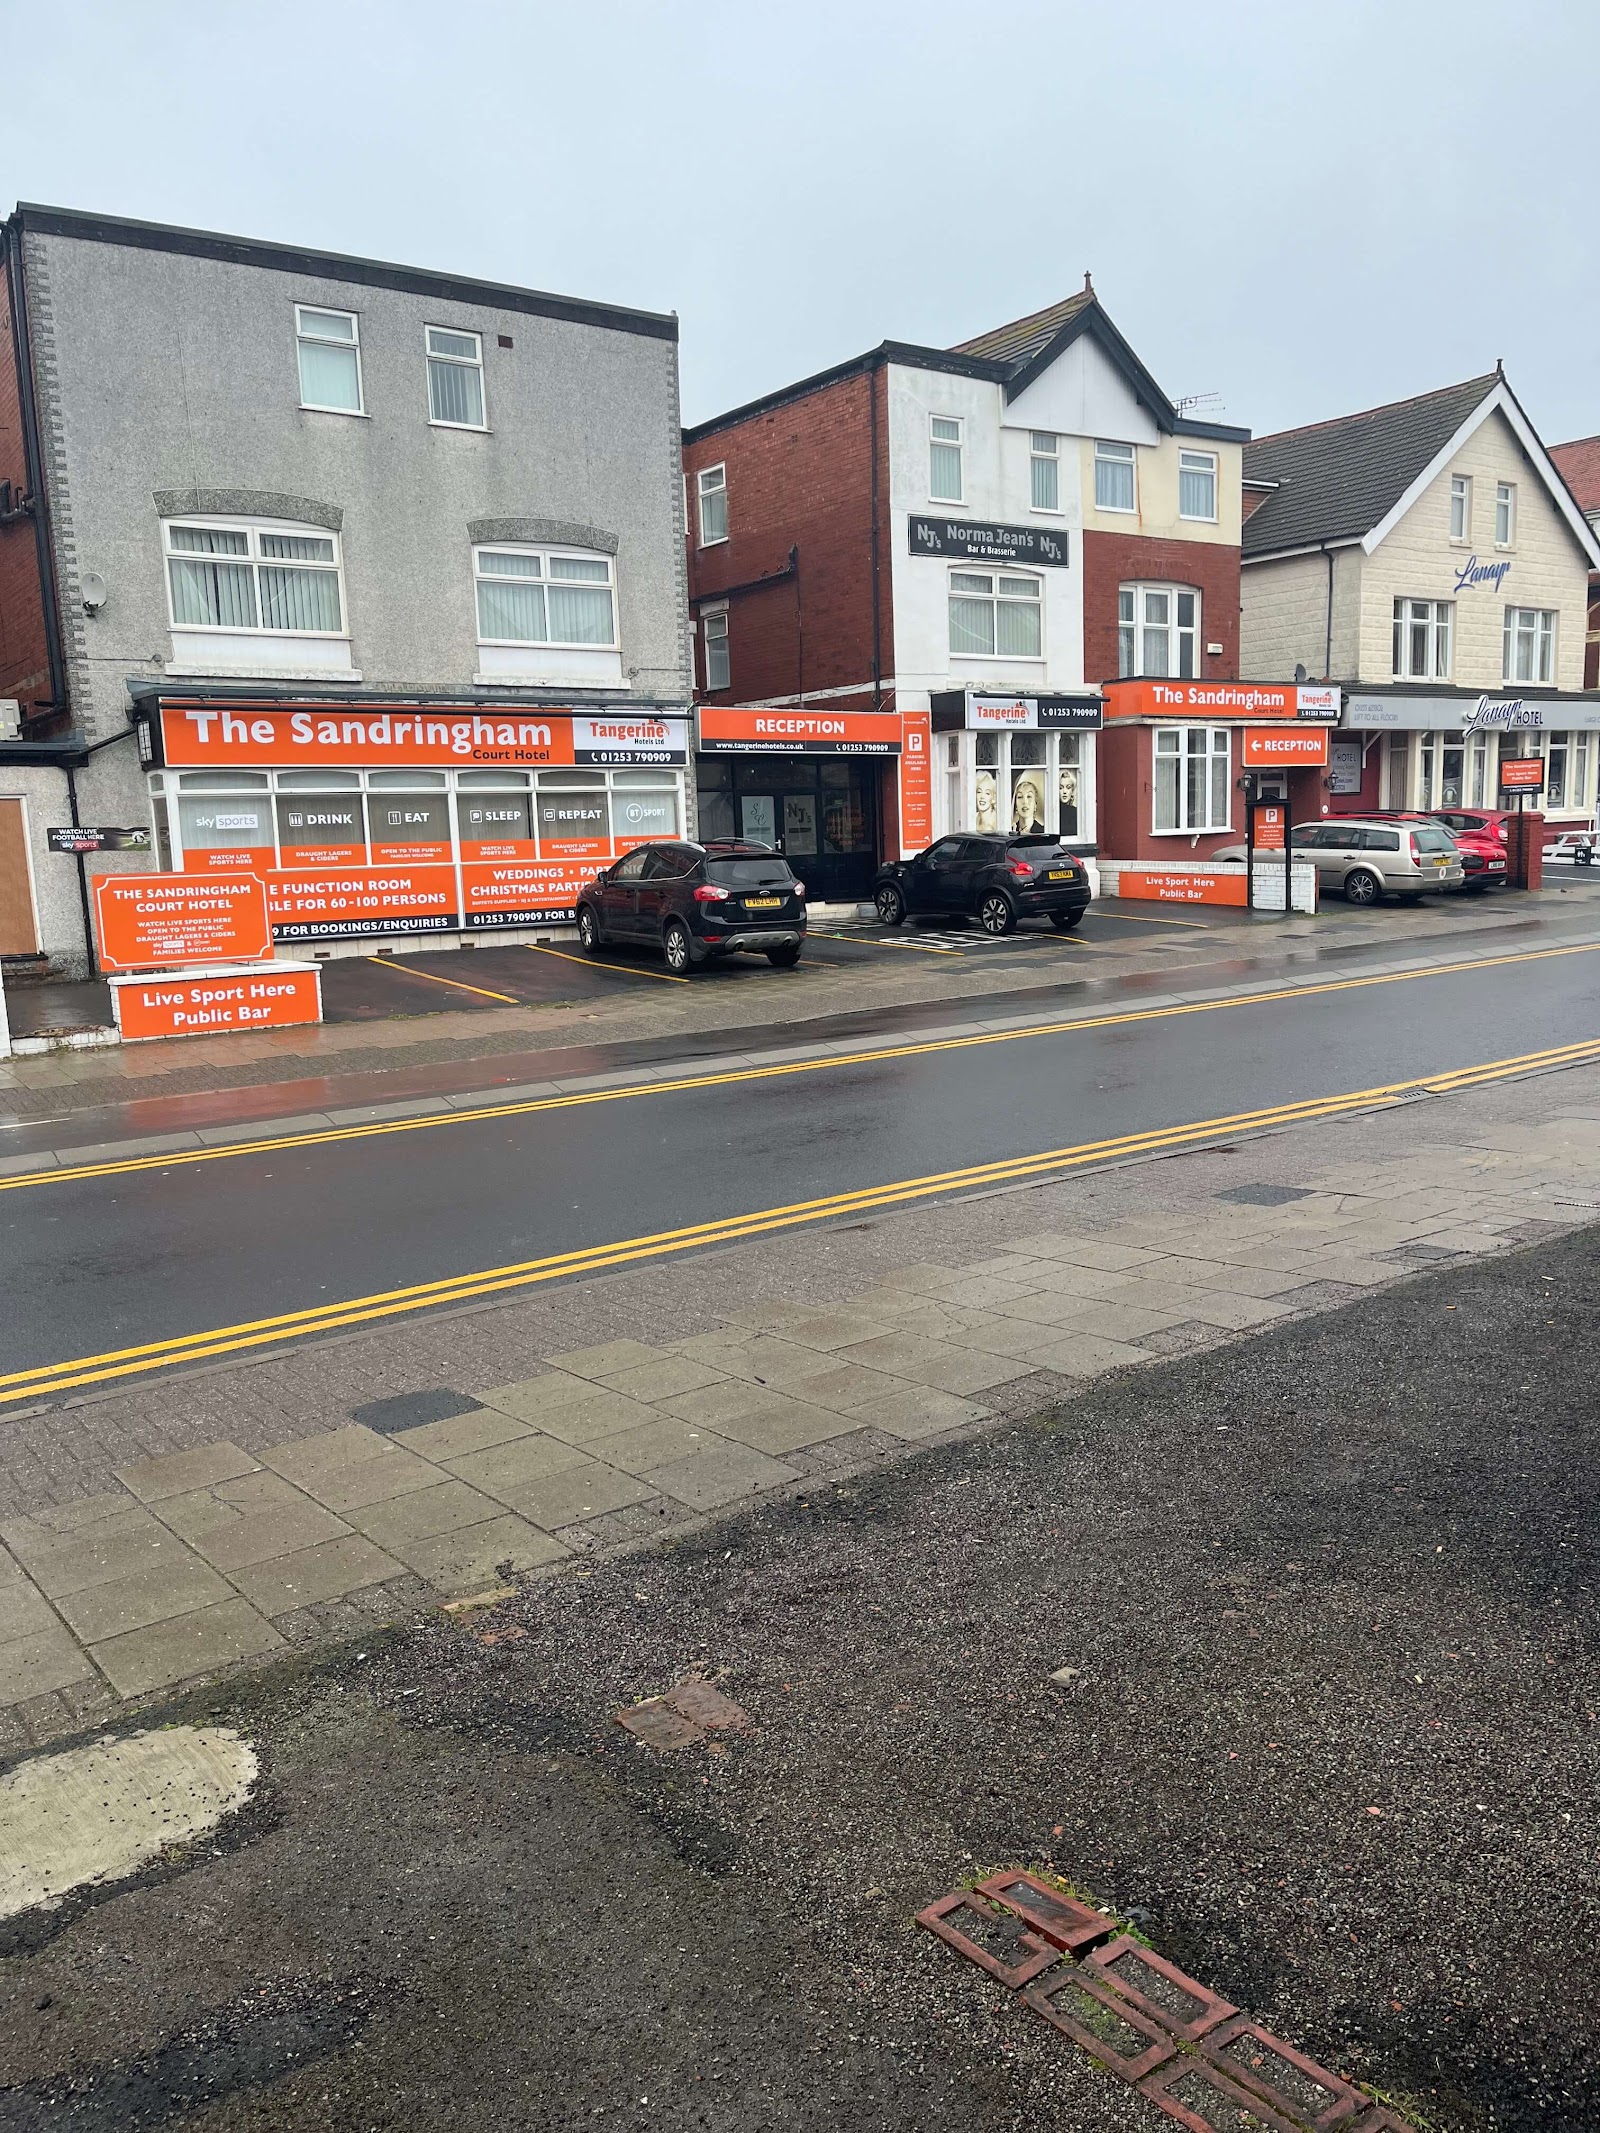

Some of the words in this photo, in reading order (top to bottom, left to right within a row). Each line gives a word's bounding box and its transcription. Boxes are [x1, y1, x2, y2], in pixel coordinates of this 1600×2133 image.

[947, 524, 994, 543] Norma
[996, 528, 1034, 547] Jean's
[967, 544, 979, 553] Bar
[980, 545, 986, 554] &
[987, 546, 1017, 557] Brasserie
[1153, 686, 1184, 704] The
[1188, 687, 1285, 710] Sandringham
[1302, 694, 1331, 705] Tangerine
[977, 706, 1026, 720] Tangerine
[1048, 707, 1070, 716] 01253
[1072, 708, 1098, 717] 790909
[1516, 711, 1544, 725] HOTEL
[590, 722, 664, 741] Tangerine
[755, 718, 845, 734] RECEPTION
[185, 711, 275, 744] The
[290, 712, 552, 754] Sandringham
[716, 741, 804, 751] www.tangerinehotels.co.uk
[842, 744, 863, 752] 01253
[864, 744, 889, 753] 790909
[912, 736, 920, 749] P
[1264, 740, 1322, 752] RECEPTION
[472, 749, 511, 760] Court
[514, 750, 550, 760] Hotel
[600, 752, 632, 762] 01253
[635, 752, 672, 762] 790909
[1337, 753, 1356, 762] HOTEL
[405, 812, 430, 823] EAT
[485, 811, 522, 821] SLEEP
[558, 810, 602, 820] REPEAT
[629, 808, 639, 817] BT
[643, 808, 666, 817] SPORT
[1268, 810, 1275, 821] P
[196, 816, 215, 828] sky
[218, 816, 256, 828] sports
[307, 814, 353, 825] DRINK
[61, 841, 74, 849] sky
[75, 841, 97, 849] sports
[493, 867, 565, 881] WEDDINGS
[283, 880, 364, 895] FUNCTION
[368, 879, 412, 891] ROOM
[1146, 876, 1163, 885] Live
[1165, 876, 1189, 887] Sport
[1193, 877, 1215, 887] Here
[113, 889, 143, 900] THE
[146, 884, 251, 899] SANDRINGHAM
[470, 883, 545, 897] CHRISTMAS
[1159, 889, 1185, 899] Public
[1187, 889, 1203, 899] Bar
[136, 901, 185, 913] COURT
[188, 899, 233, 911] HOTEL
[296, 898, 327, 911] FOR
[382, 893, 447, 906] PERSONS
[473, 913, 504, 925] 01253
[506, 911, 543, 923] 790909
[545, 909, 566, 920] FOR
[198, 924, 224, 932] PUBLIC
[283, 925, 309, 936] FOR
[311, 917, 448, 935] BOOKINGS/ENQUIRIES
[136, 934, 173, 943] DRAUGHT
[175, 932, 202, 940] LAGERS
[210, 930, 236, 938] CIDERS
[152, 948, 185, 956] FAMILIES
[187, 946, 223, 954] WELCOME
[143, 992, 184, 1007] Live
[190, 986, 244, 1006] Sport
[249, 983, 296, 998] Here
[173, 1008, 233, 1026] Public
[238, 1006, 272, 1021] Bar
